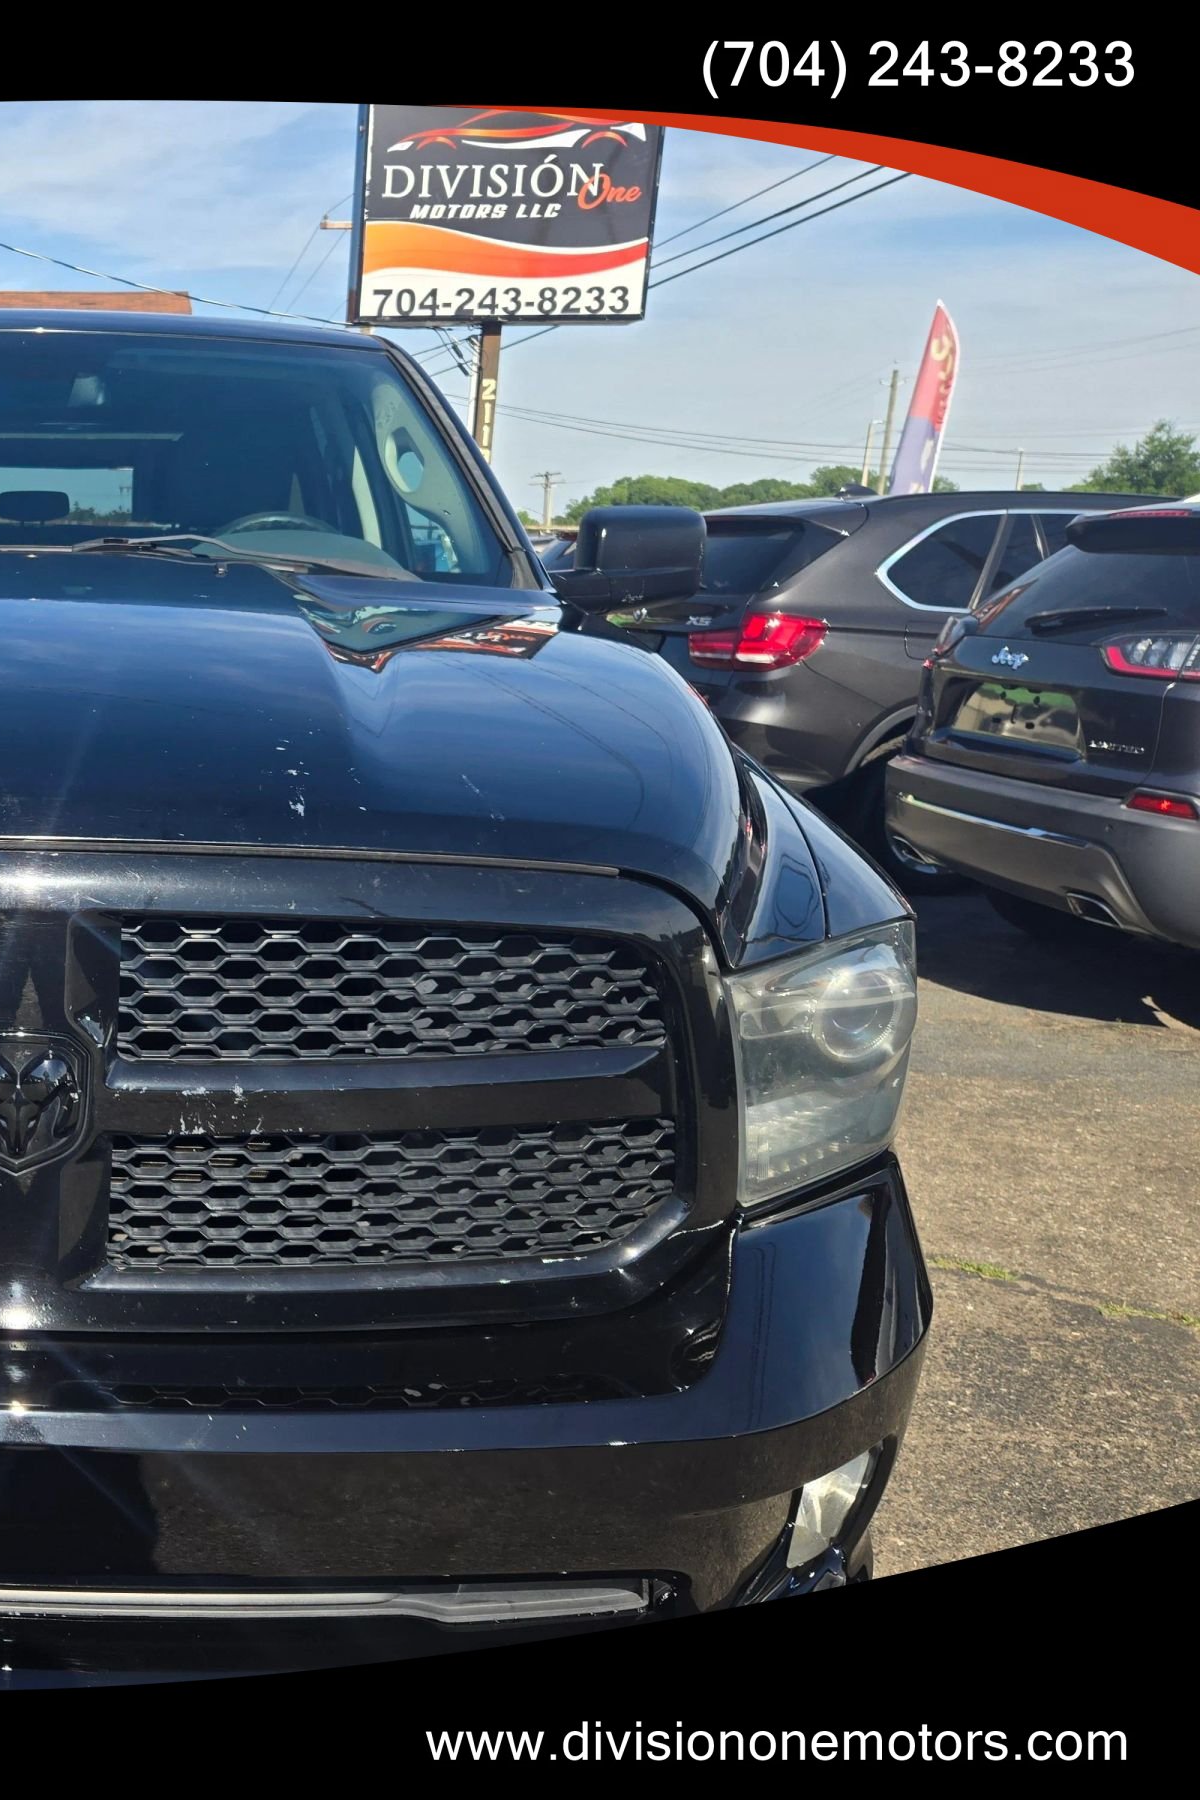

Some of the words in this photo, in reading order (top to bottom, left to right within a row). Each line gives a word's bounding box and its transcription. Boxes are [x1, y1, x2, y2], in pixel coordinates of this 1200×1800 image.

[382, 154, 603, 199] DIVISIÓN
[578, 173, 642, 210] One
[409, 203, 508, 220] MOTORS
[515, 202, 562, 219] LLC
[372, 286, 629, 318] 704-243-8233
